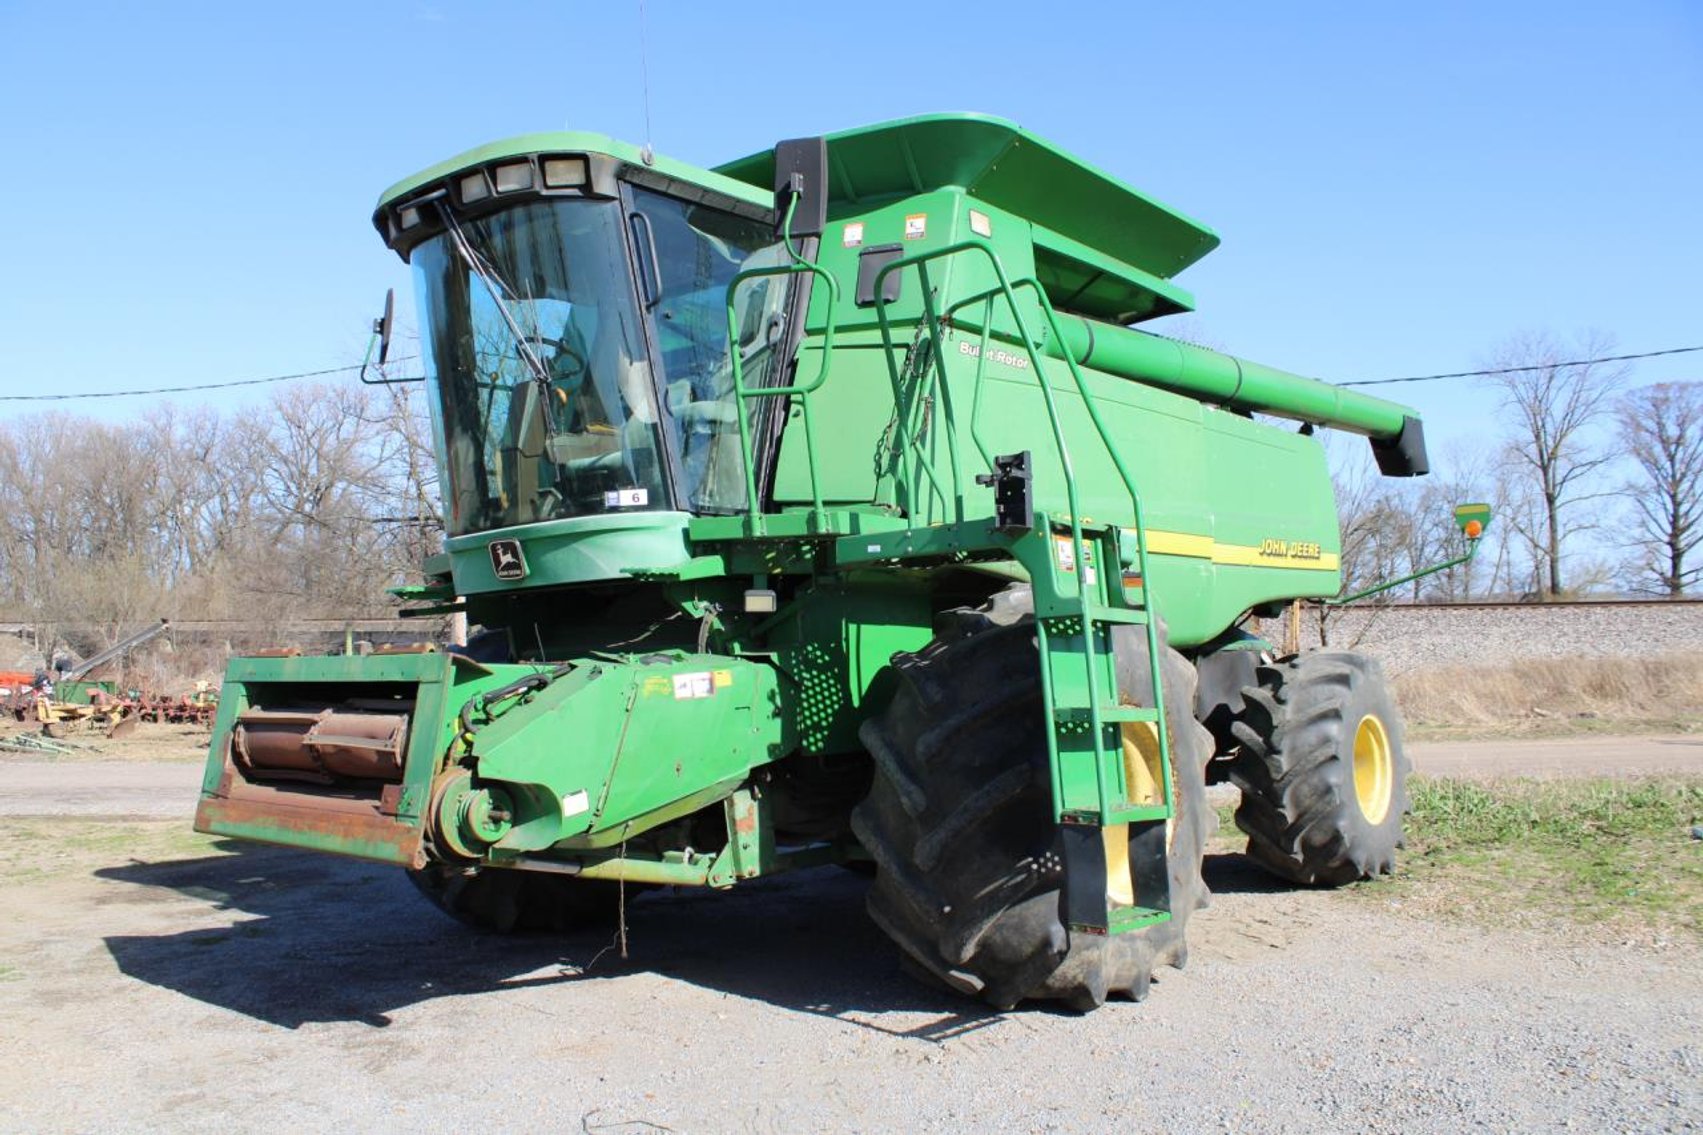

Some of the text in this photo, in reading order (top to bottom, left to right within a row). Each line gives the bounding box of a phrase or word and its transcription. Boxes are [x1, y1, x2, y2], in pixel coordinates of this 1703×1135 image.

[960, 341, 1028, 368] Bult Rotor
[632, 493, 640, 503] 6
[1259, 539, 1320, 559] JOHN DEERE
